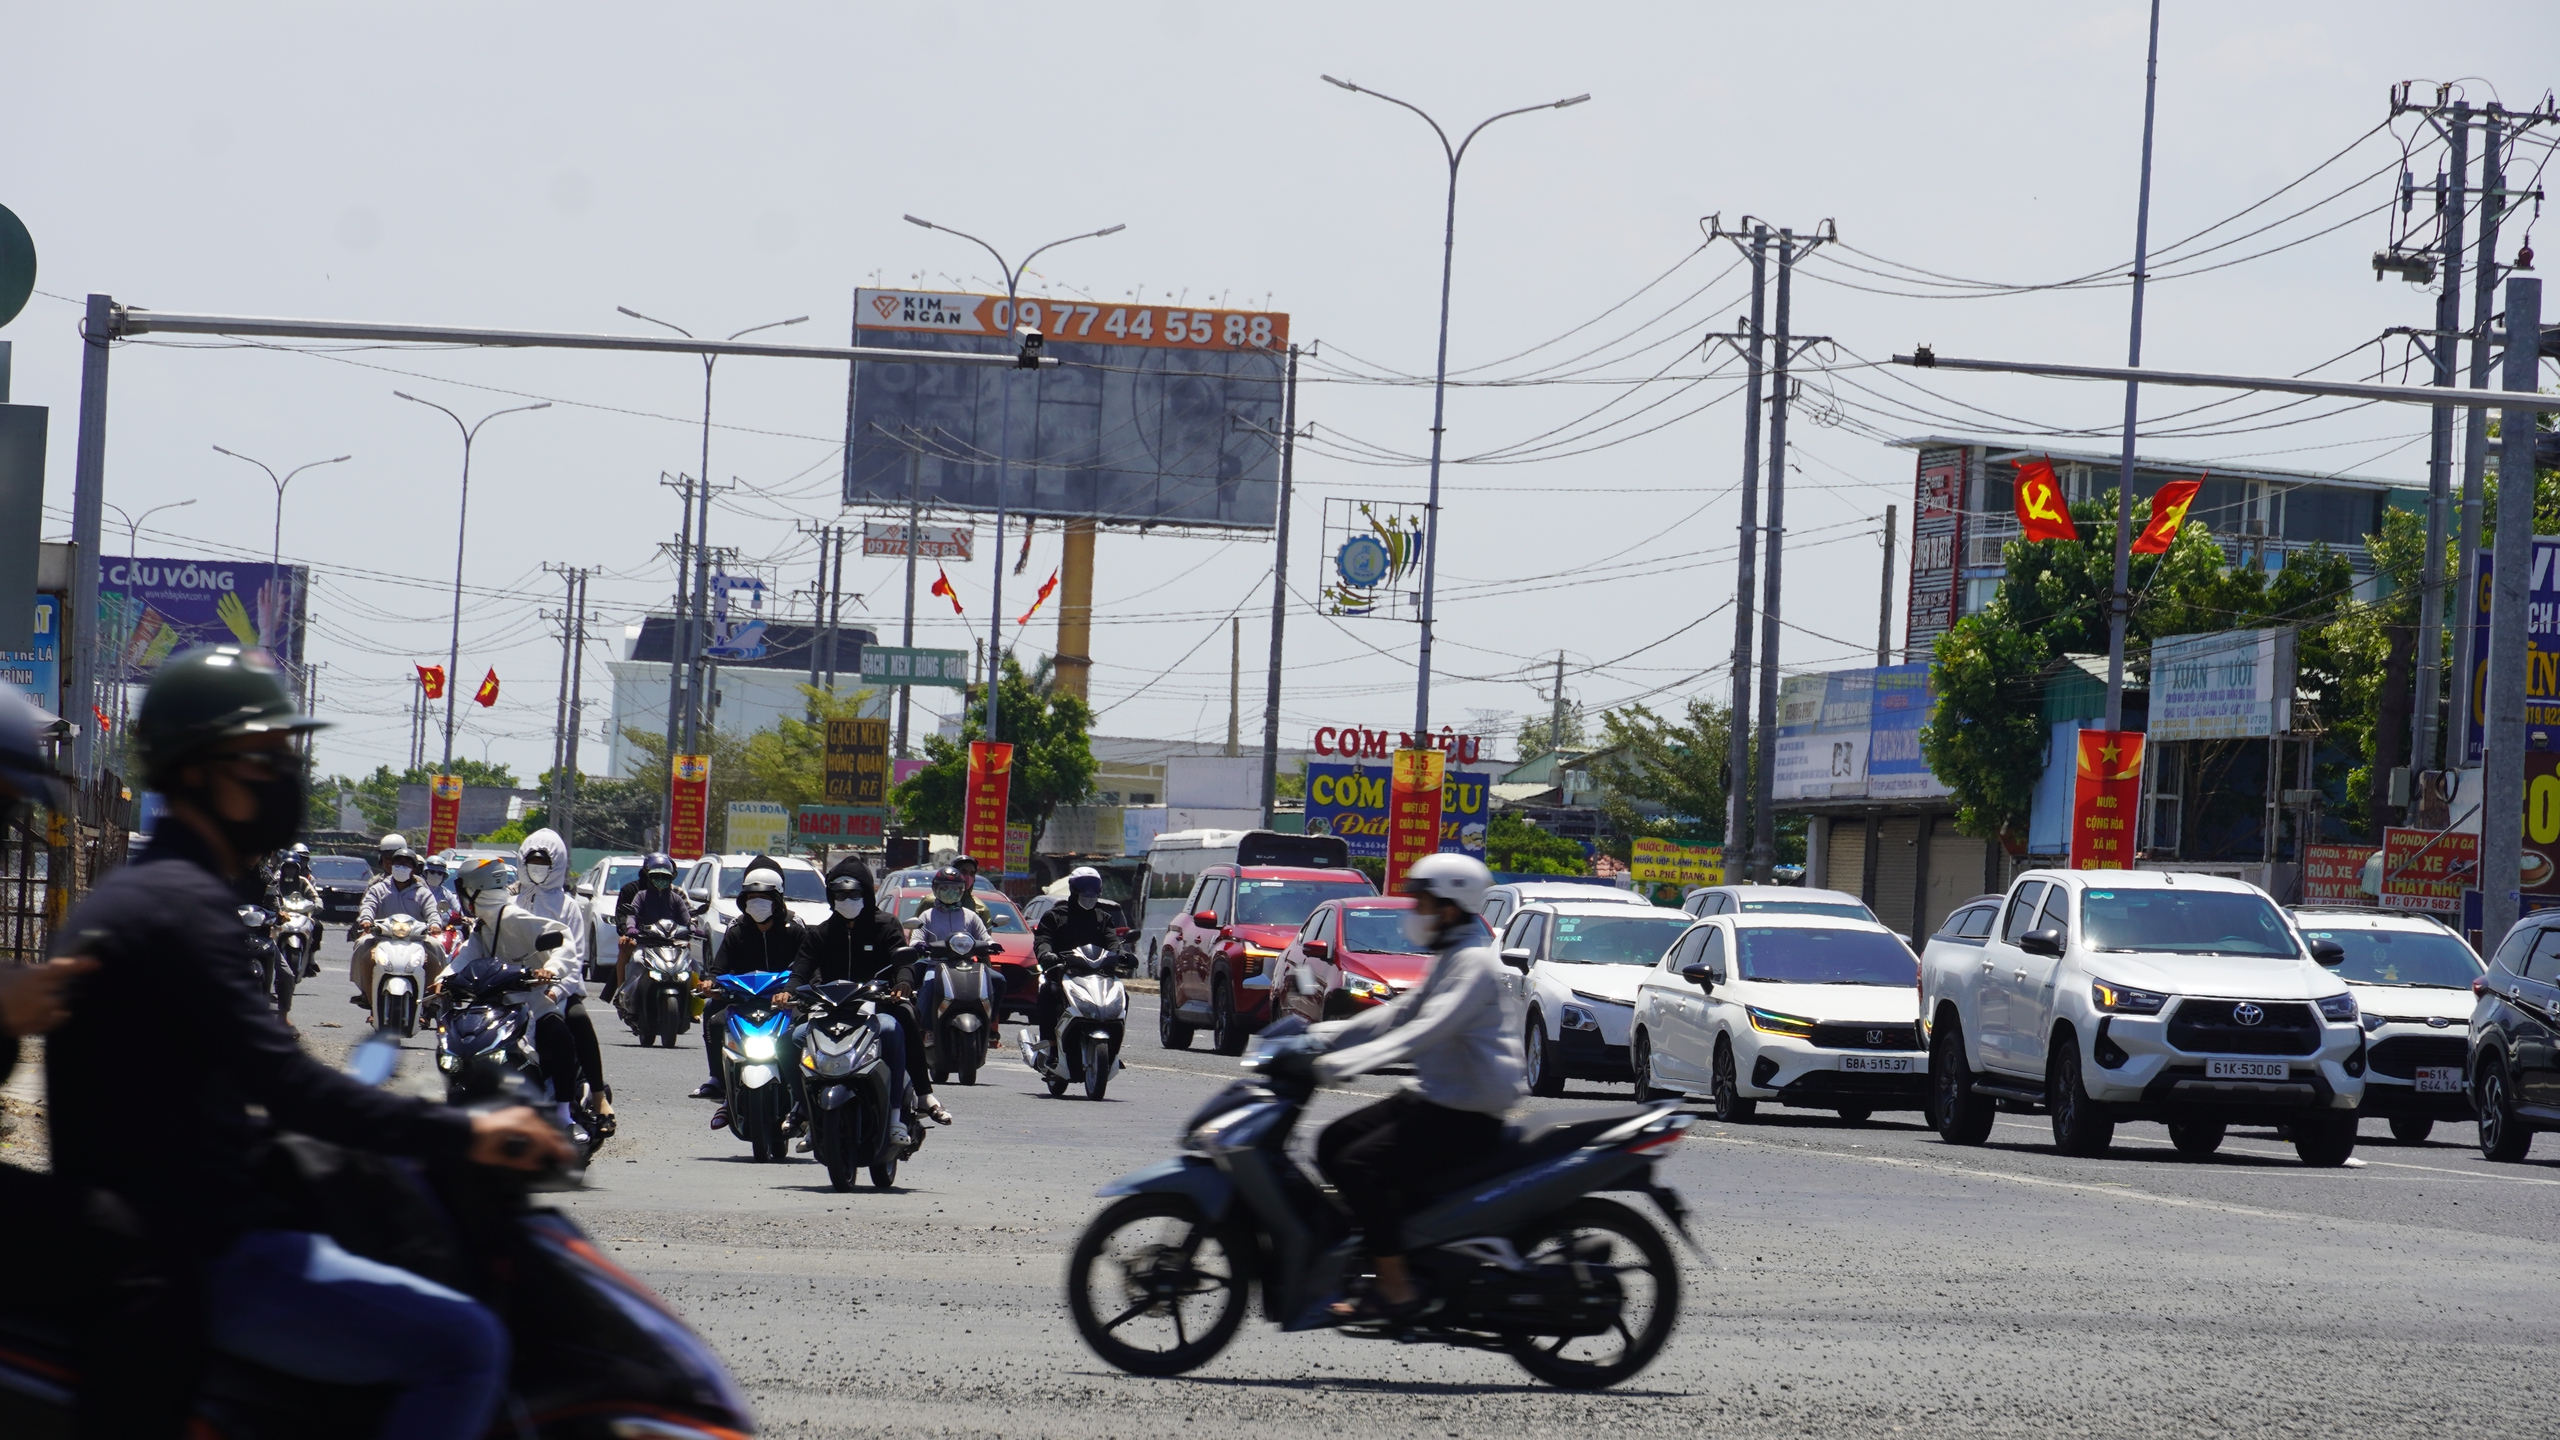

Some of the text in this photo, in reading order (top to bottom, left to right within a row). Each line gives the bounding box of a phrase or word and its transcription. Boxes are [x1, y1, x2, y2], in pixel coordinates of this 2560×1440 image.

[904, 297, 941, 310] KIM
[904, 310, 961, 324] NGAN
[993, 300, 1272, 347] 09 77 44 55 88
[868, 541, 884, 553] 09
[886, 541, 903, 554] 77
[38, 645, 53, 661] LÁ
[891, 655, 910, 676] MEN
[861, 724, 884, 746] MEN
[1315, 724, 1388, 759] CƠM
[1408, 755, 1429, 771] 1.5
[829, 775, 852, 795] GIÁ
[1312, 771, 1386, 809] CƠM
[2096, 795, 2117, 808] NƯỚC
[847, 815, 881, 836] MEN
[2086, 815, 2124, 831] CỘNG HÒA
[1636, 841, 1661, 852] NƯỚC
[2093, 838, 2117, 852] XÃ HỘI
[2391, 834, 2475, 850] HONDA TAY GA
[2310, 848, 2340, 859] HONDA
[2347, 849, 2364, 860] TAY
[2387, 847, 2444, 872] RỬA XE
[2082, 856, 2099, 870] CHỦ
[2307, 860, 2352, 879] RỬA XE
[1680, 871, 1706, 881] MANG
[2308, 882, 2341, 897] THAY
[2387, 878, 2427, 895] THAY
[2403, 896, 2428, 908] 0797
[2431, 898, 2450, 909] 562
[1846, 1058, 1908, 1071] 68A-515.37
[2214, 1062, 2282, 1076] 61K-530.06
[2430, 1069, 2450, 1080] 61K
[2420, 1080, 2457, 1091] 644.14
